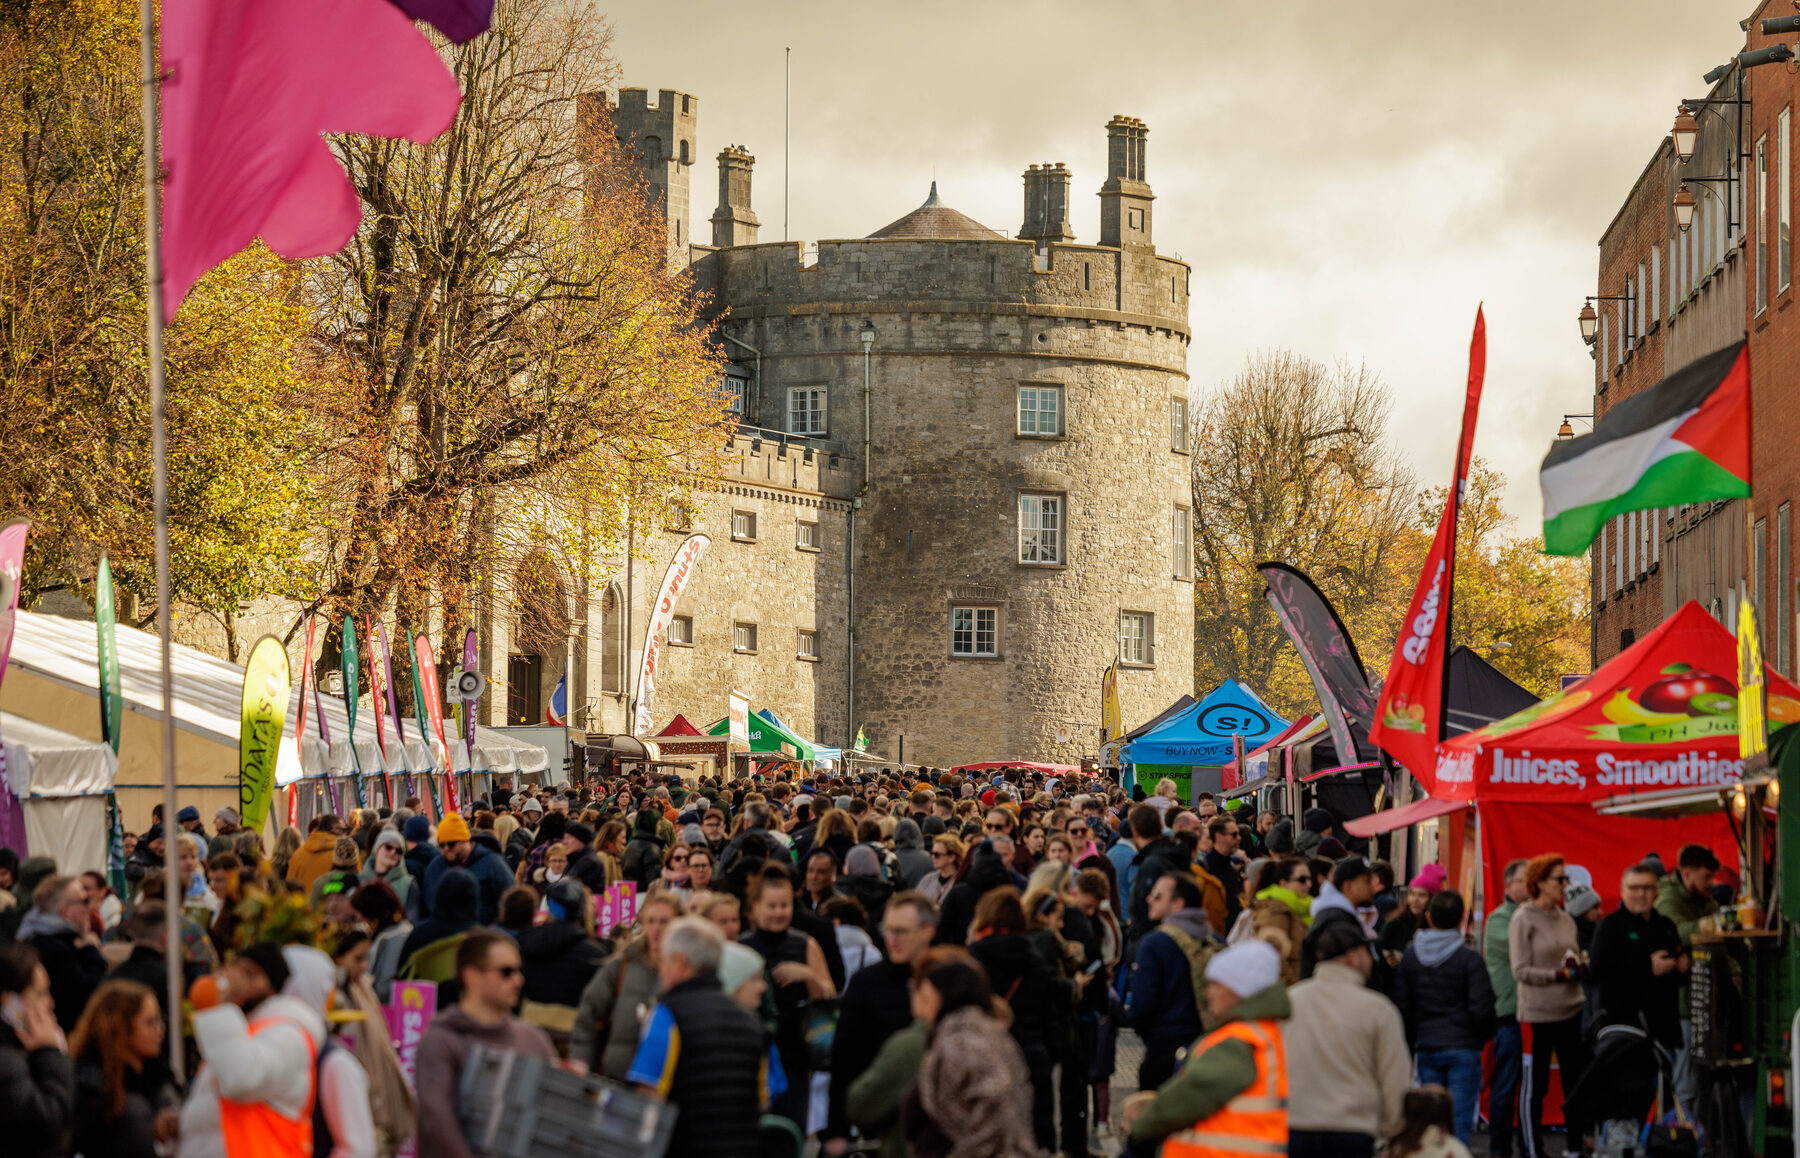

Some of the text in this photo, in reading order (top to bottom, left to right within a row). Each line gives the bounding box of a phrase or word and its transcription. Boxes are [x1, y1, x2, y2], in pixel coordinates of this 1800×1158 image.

[1215, 716, 1252, 731] S!
[1165, 745, 1189, 756] BUY
[1189, 745, 1218, 756] NOW
[1489, 747, 1587, 790] Juices,
[1595, 750, 1746, 786] Smoothies
